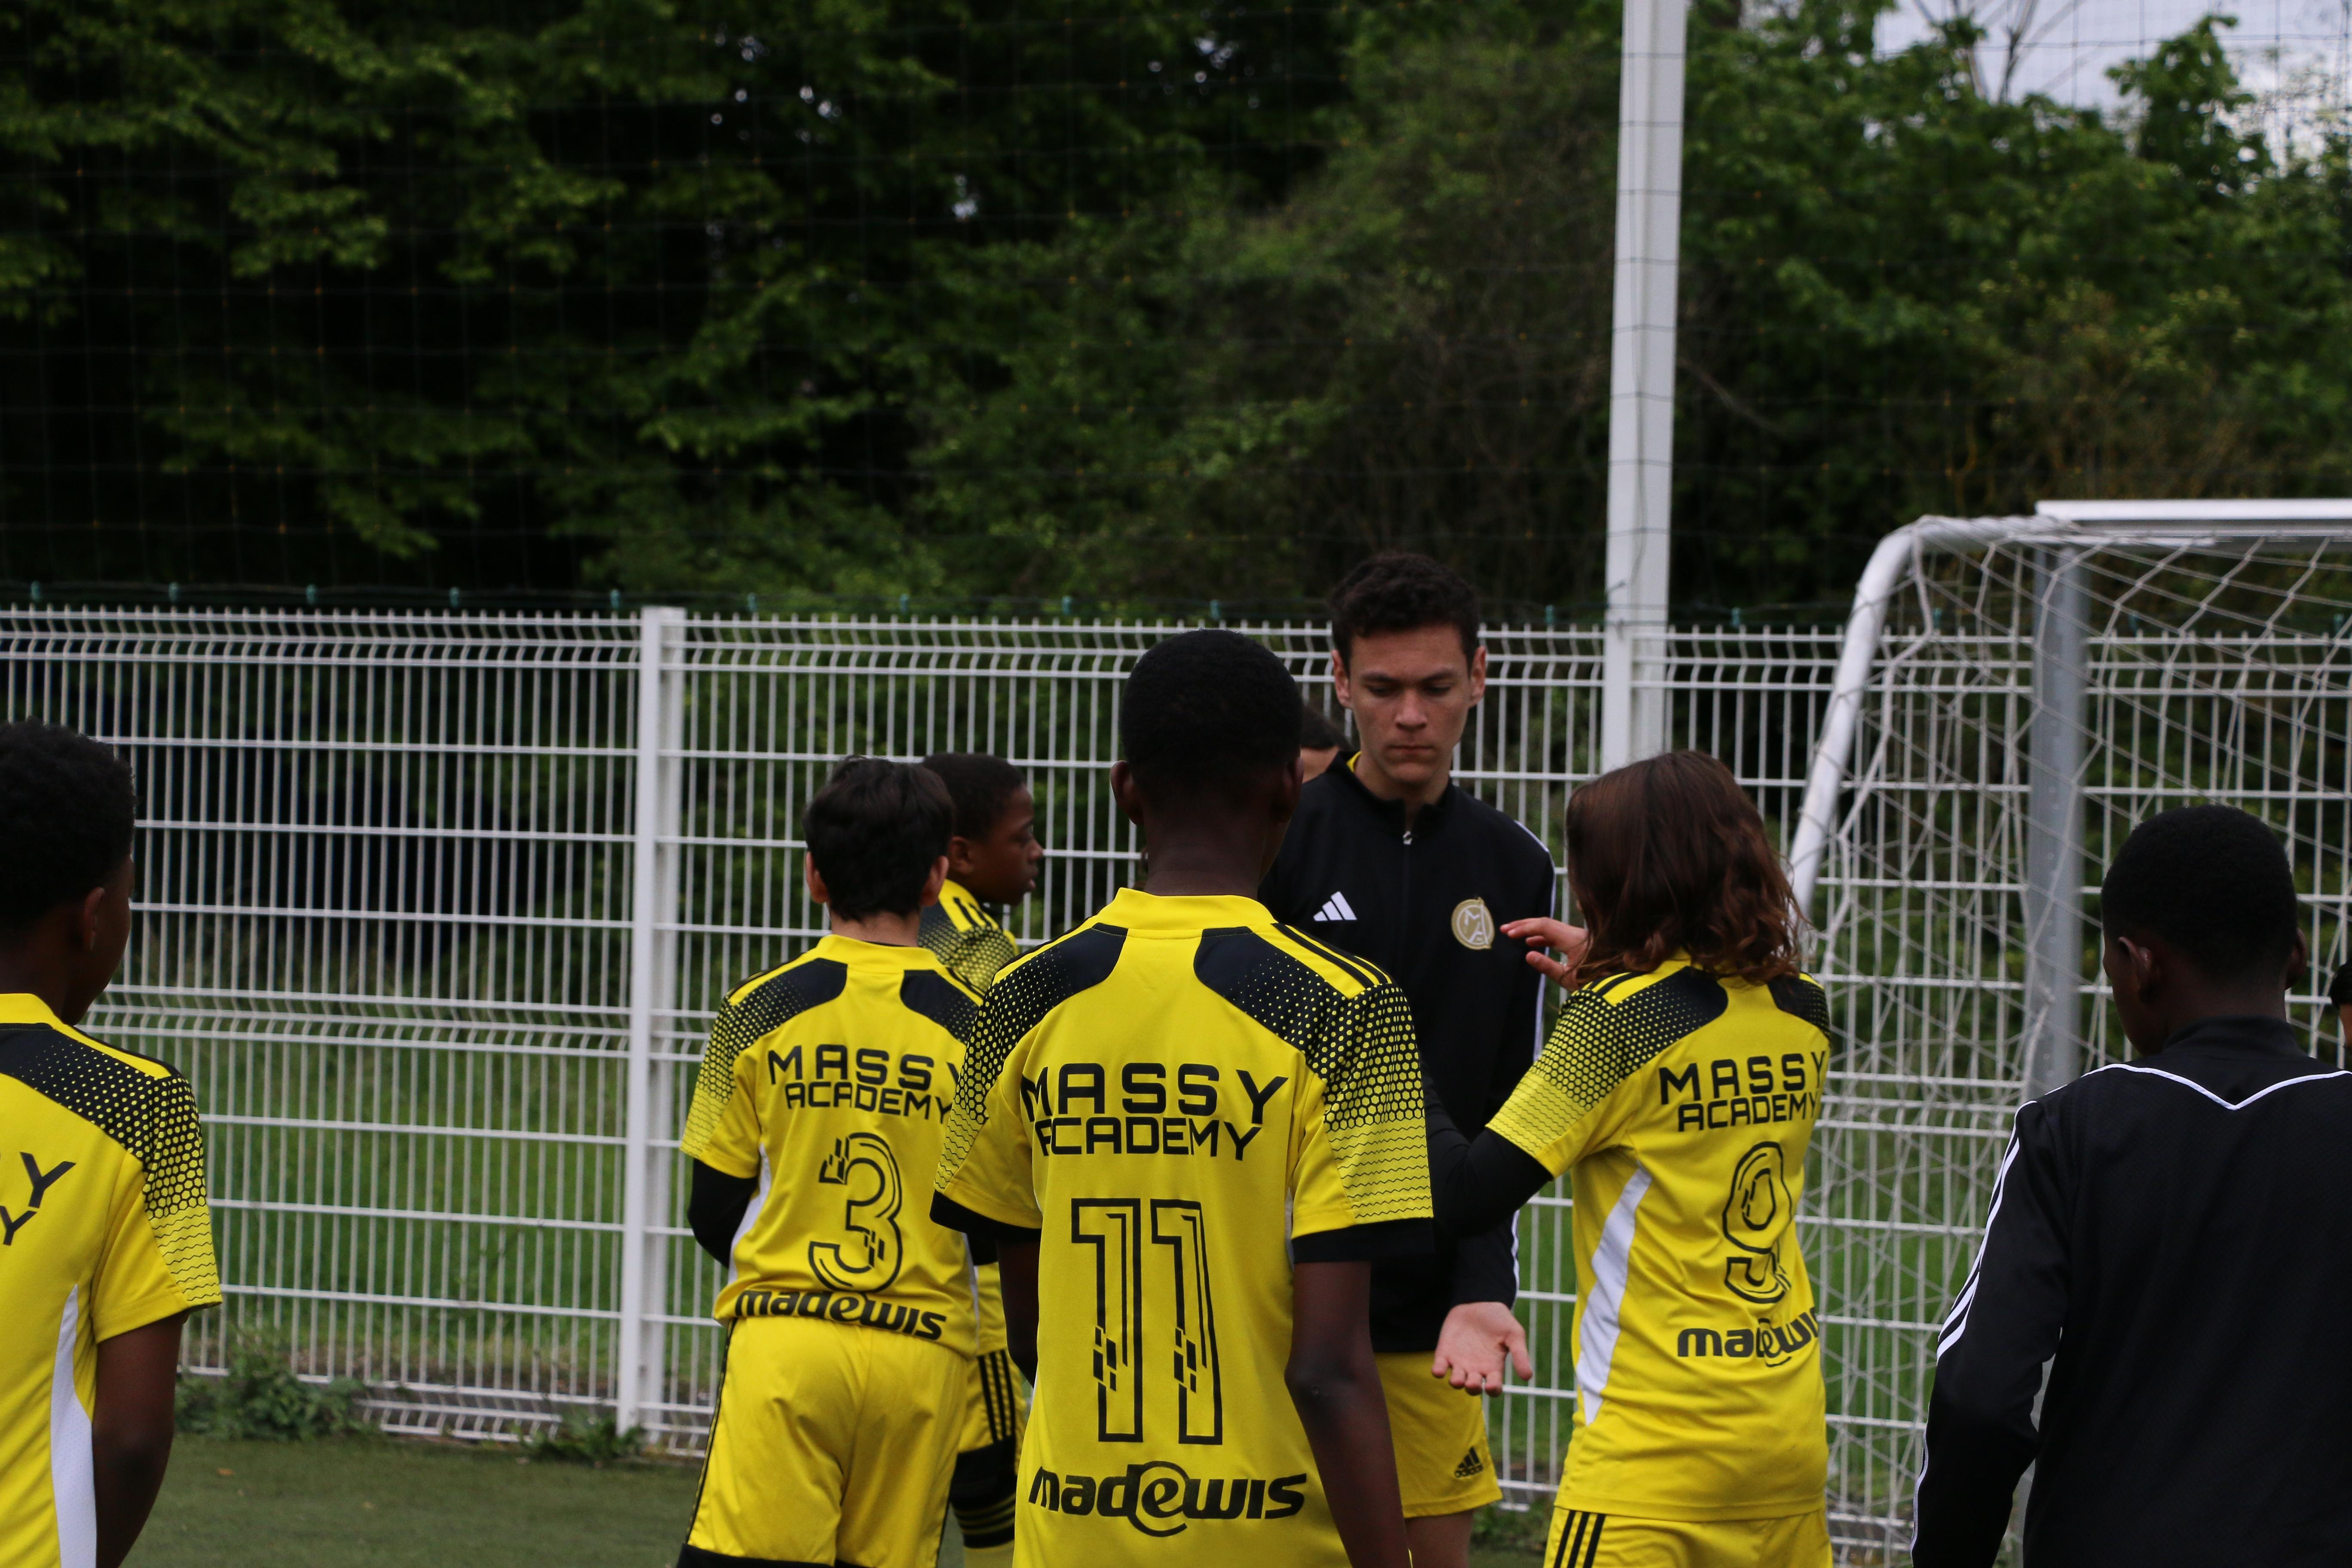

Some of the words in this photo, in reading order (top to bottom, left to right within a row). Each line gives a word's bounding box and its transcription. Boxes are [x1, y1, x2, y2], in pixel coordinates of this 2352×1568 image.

[785, 1081, 952, 1124] ACADEMY
[1020, 1063, 1289, 1124] MASSY
[1659, 1051, 1825, 1105] MASSY
[1035, 1117, 1262, 1161] ACADEMY
[1678, 1091, 1818, 1132] ACADEMY
[808, 1132, 902, 1291] 3
[1722, 1141, 1792, 1303] 9
[1071, 1198, 1223, 1445] 11
[1678, 1307, 1818, 1367] maewi
